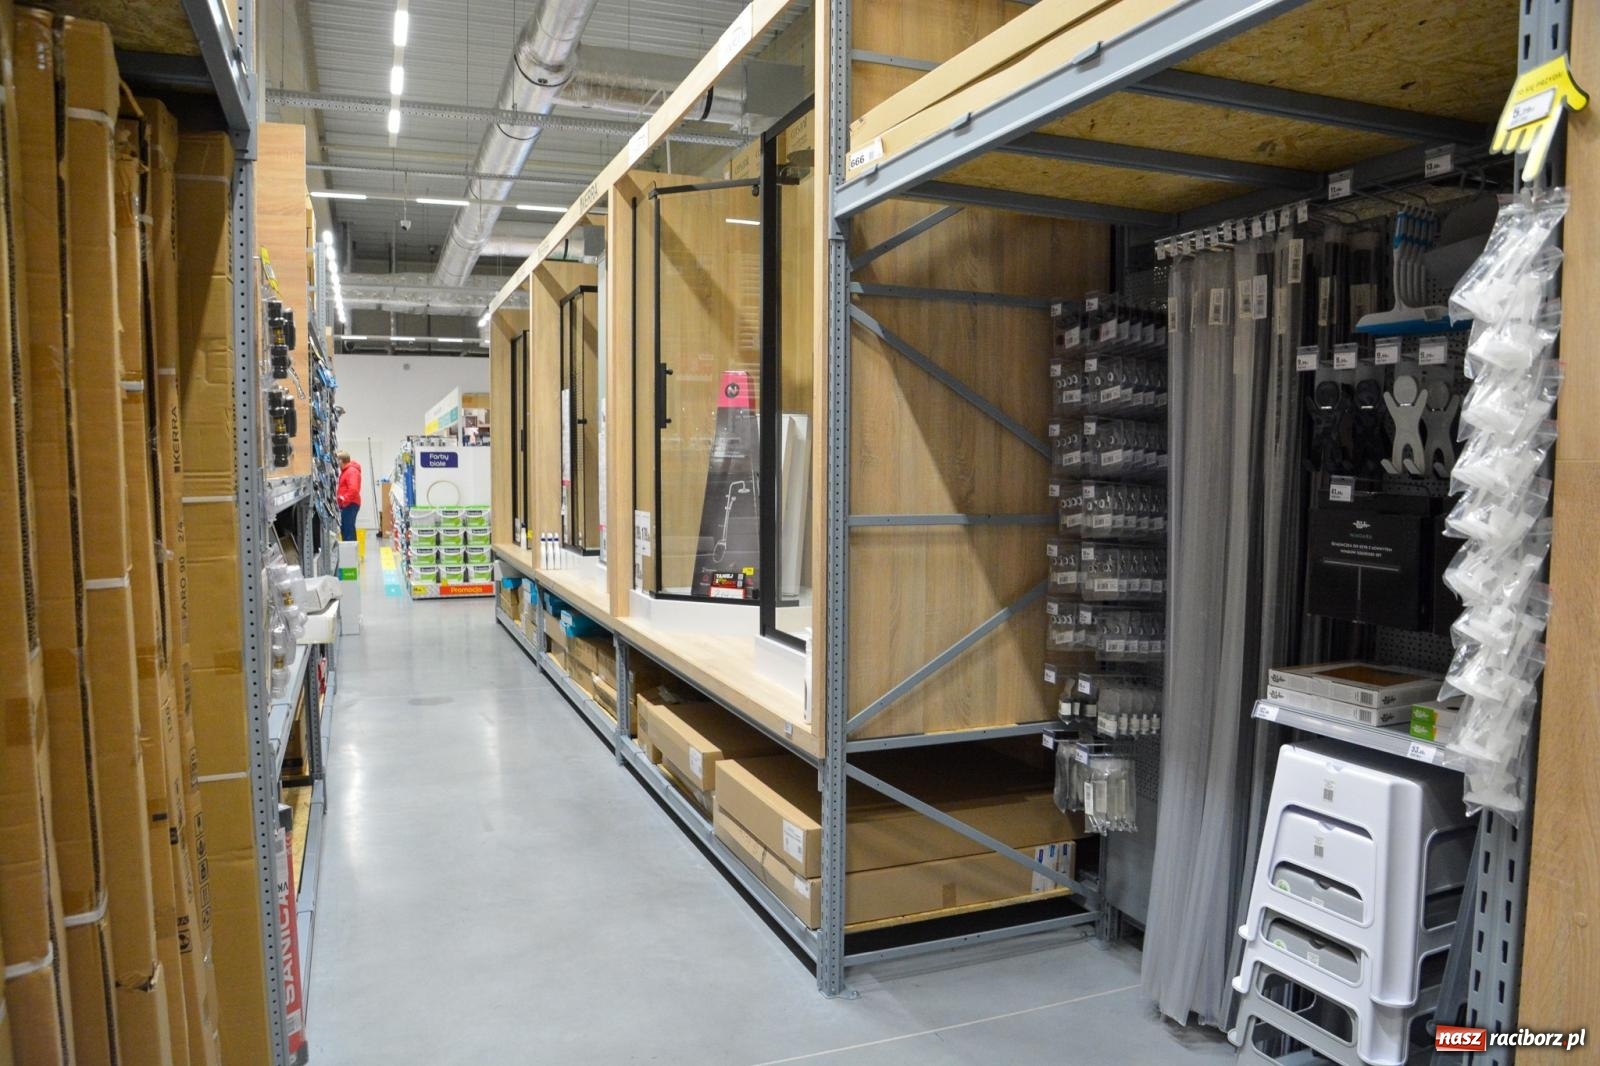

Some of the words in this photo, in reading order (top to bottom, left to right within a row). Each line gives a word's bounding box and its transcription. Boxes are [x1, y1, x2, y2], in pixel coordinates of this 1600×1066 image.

[850, 154, 865, 168] 666
[171, 406, 181, 464] KERRA
[178, 556, 186, 573] 90
[279, 891, 296, 1005] SANICA
